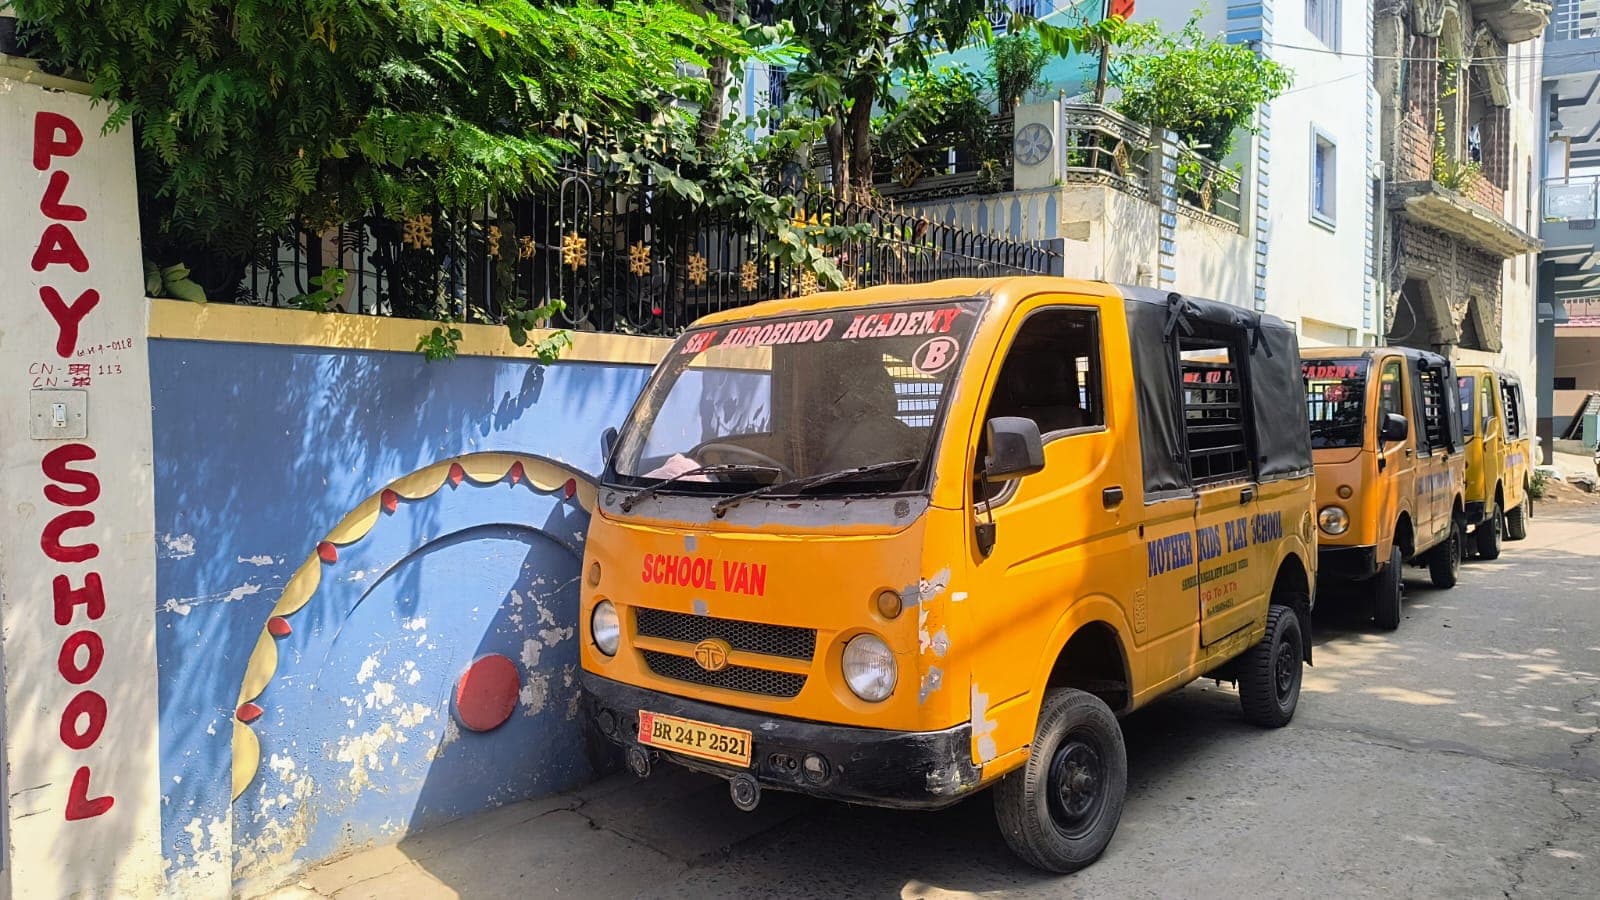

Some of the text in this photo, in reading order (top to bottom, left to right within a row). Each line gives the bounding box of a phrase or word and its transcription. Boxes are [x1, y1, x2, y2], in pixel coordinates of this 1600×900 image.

[681, 308, 963, 354] SRI AUROBINDO ACADEMY
[98, 364, 122, 376] 113
[921, 341, 950, 369] B
[1301, 365, 1358, 378] CADEMY
[31, 110, 115, 821] PLAY SCHOOL
[1148, 532, 1193, 577] MOTHER
[1197, 525, 1221, 561] KIDS
[1225, 518, 1248, 552] PLAY
[1251, 511, 1283, 544] SCHOOL
[642, 553, 767, 596] SCHOOL VAN
[653, 721, 672, 741] BR
[675, 726, 694, 746] 24
[696, 730, 707, 747] P
[709, 733, 747, 757] 2521
